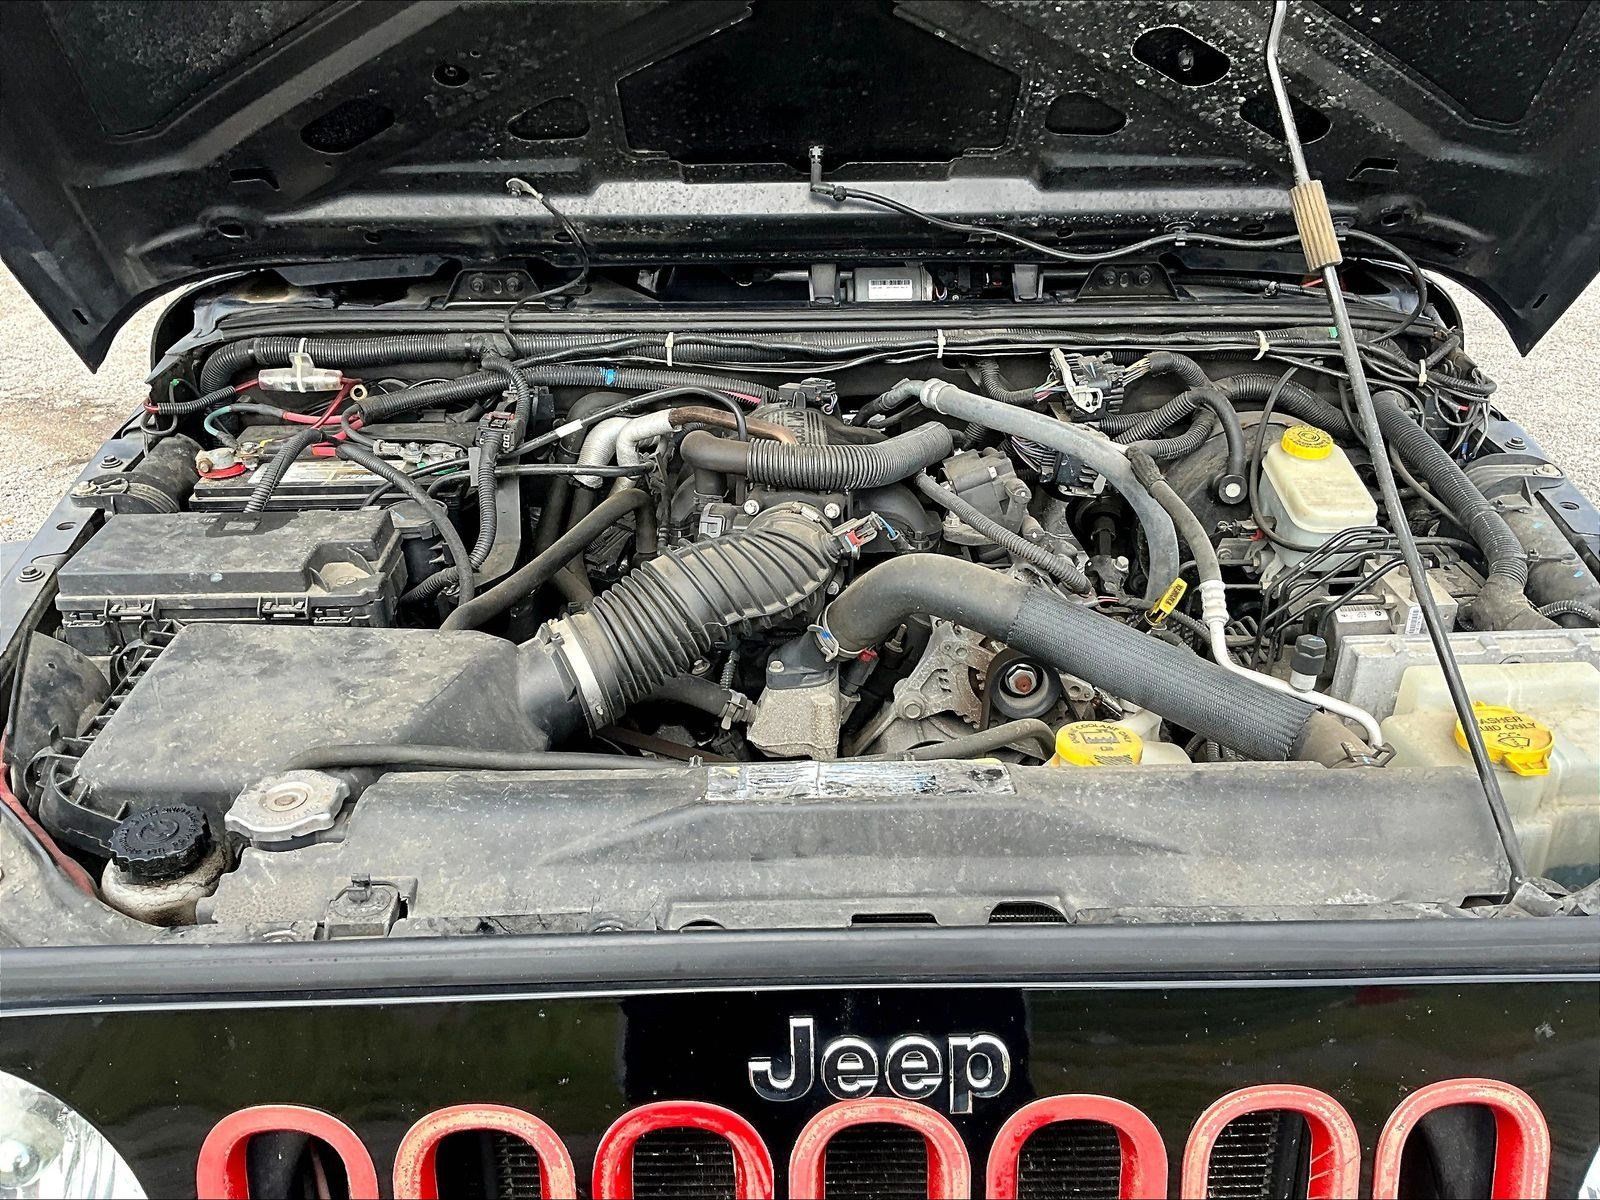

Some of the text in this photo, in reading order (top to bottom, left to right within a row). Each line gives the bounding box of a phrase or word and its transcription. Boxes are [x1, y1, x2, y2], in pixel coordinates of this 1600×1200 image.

[1479, 715, 1523, 724] ASHER
[1075, 723, 1119, 732] COOLANT
[1479, 722, 1537, 732] UID ONLY
[748, 1015, 1011, 1114] Jeep
